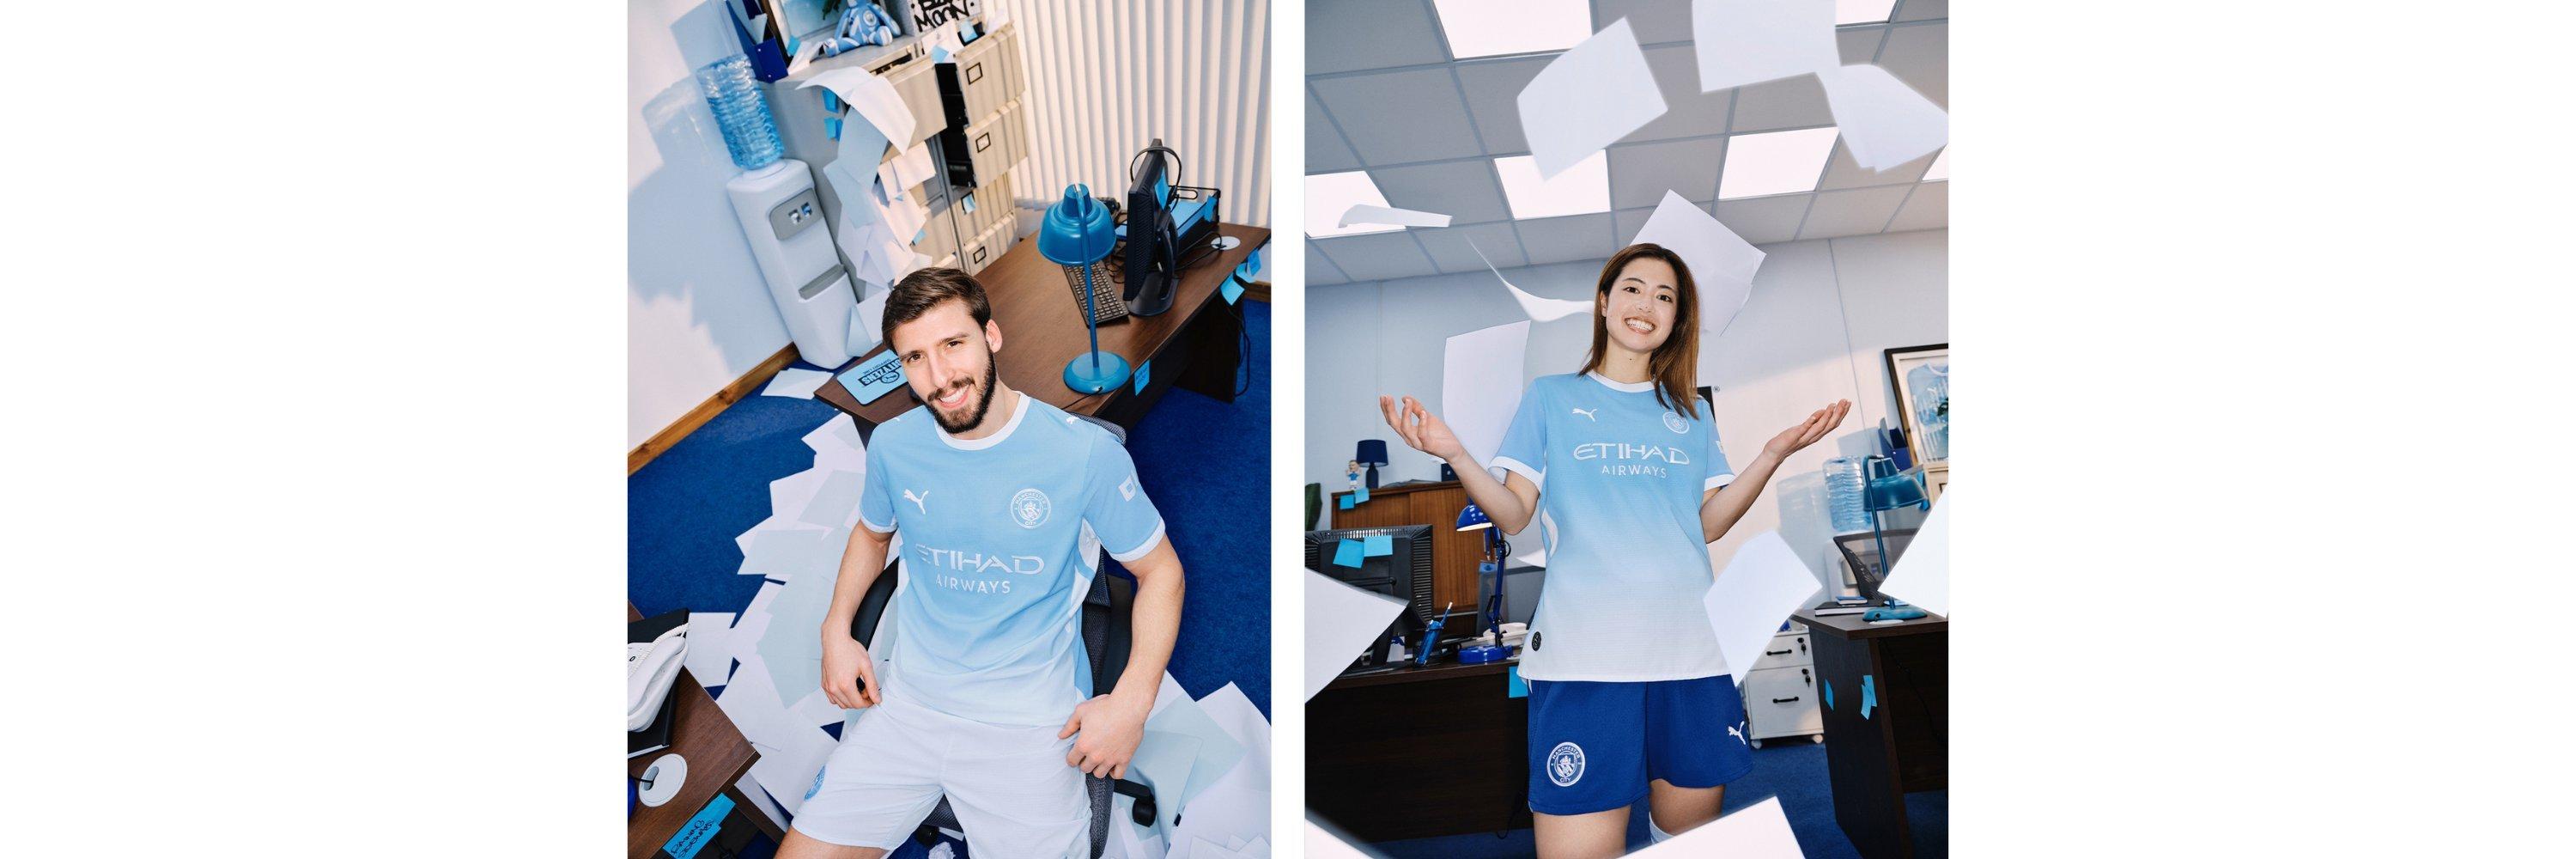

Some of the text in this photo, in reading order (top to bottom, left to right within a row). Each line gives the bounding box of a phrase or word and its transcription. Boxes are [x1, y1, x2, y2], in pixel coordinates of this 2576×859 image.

[1573, 442, 1690, 465] ETIHAD
[1601, 465, 1668, 478] AIRWAYS
[915, 543, 1045, 575] ETIHAD
[935, 573, 1011, 594] AIRWAYS
[1552, 746, 1581, 759] MANCHESTER
